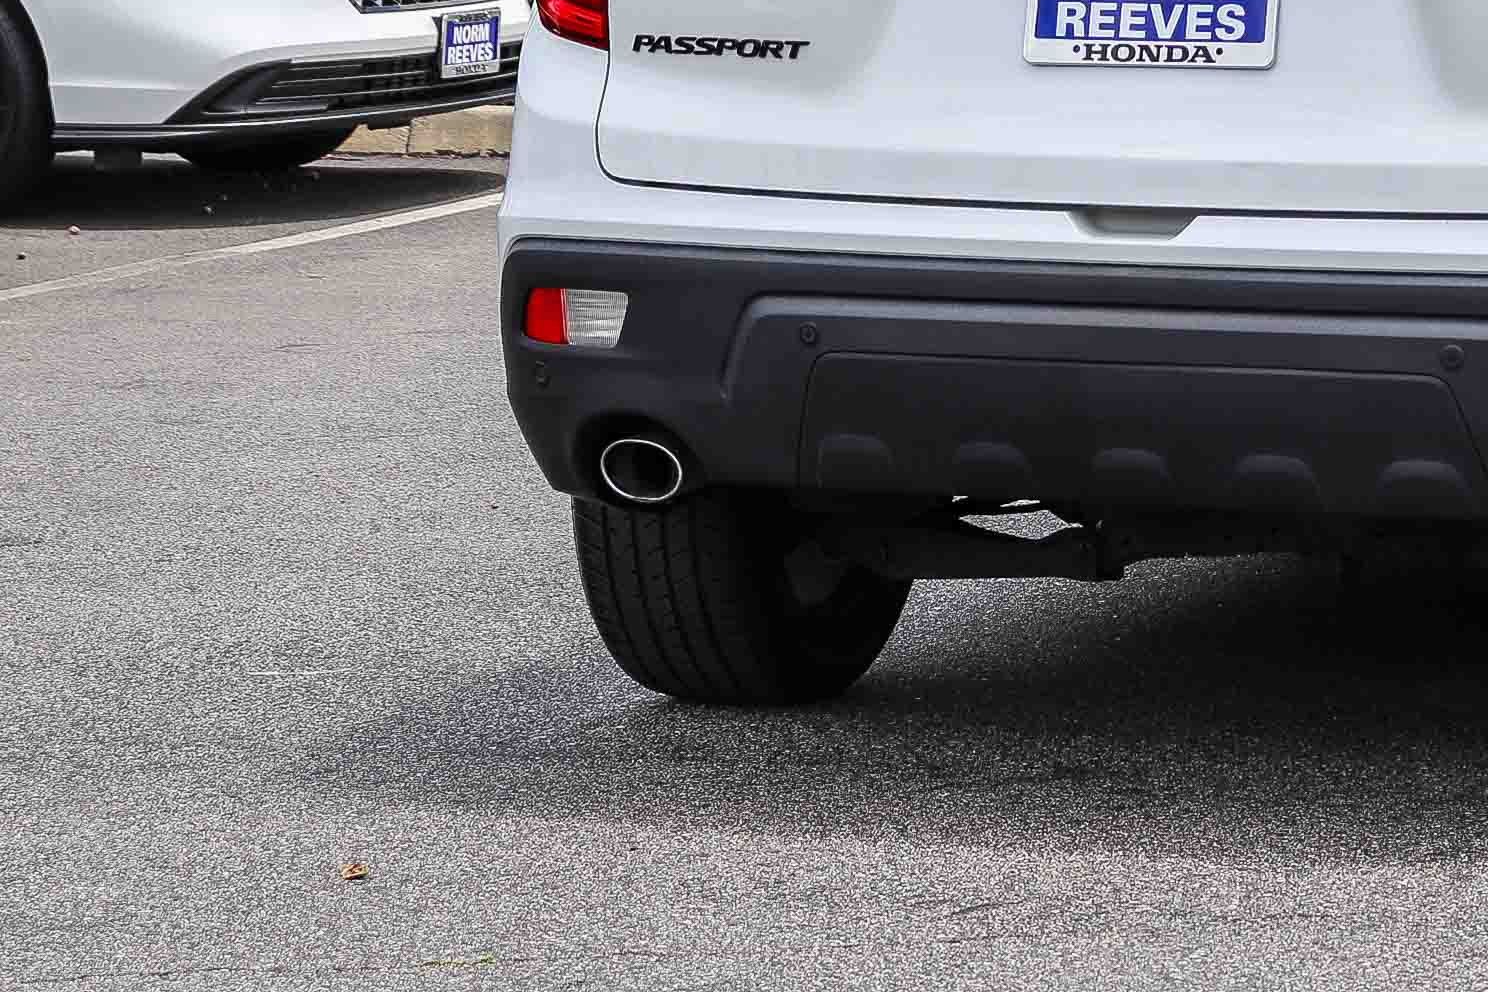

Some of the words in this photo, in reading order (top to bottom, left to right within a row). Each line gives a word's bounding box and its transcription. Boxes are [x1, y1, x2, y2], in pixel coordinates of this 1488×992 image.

[1055, 1, 1245, 41] REEVES
[453, 23, 490, 45] NORM
[447, 42, 494, 64] REEVES
[632, 34, 811, 60] PASSPORT
[1082, 43, 1216, 63] HONDA
